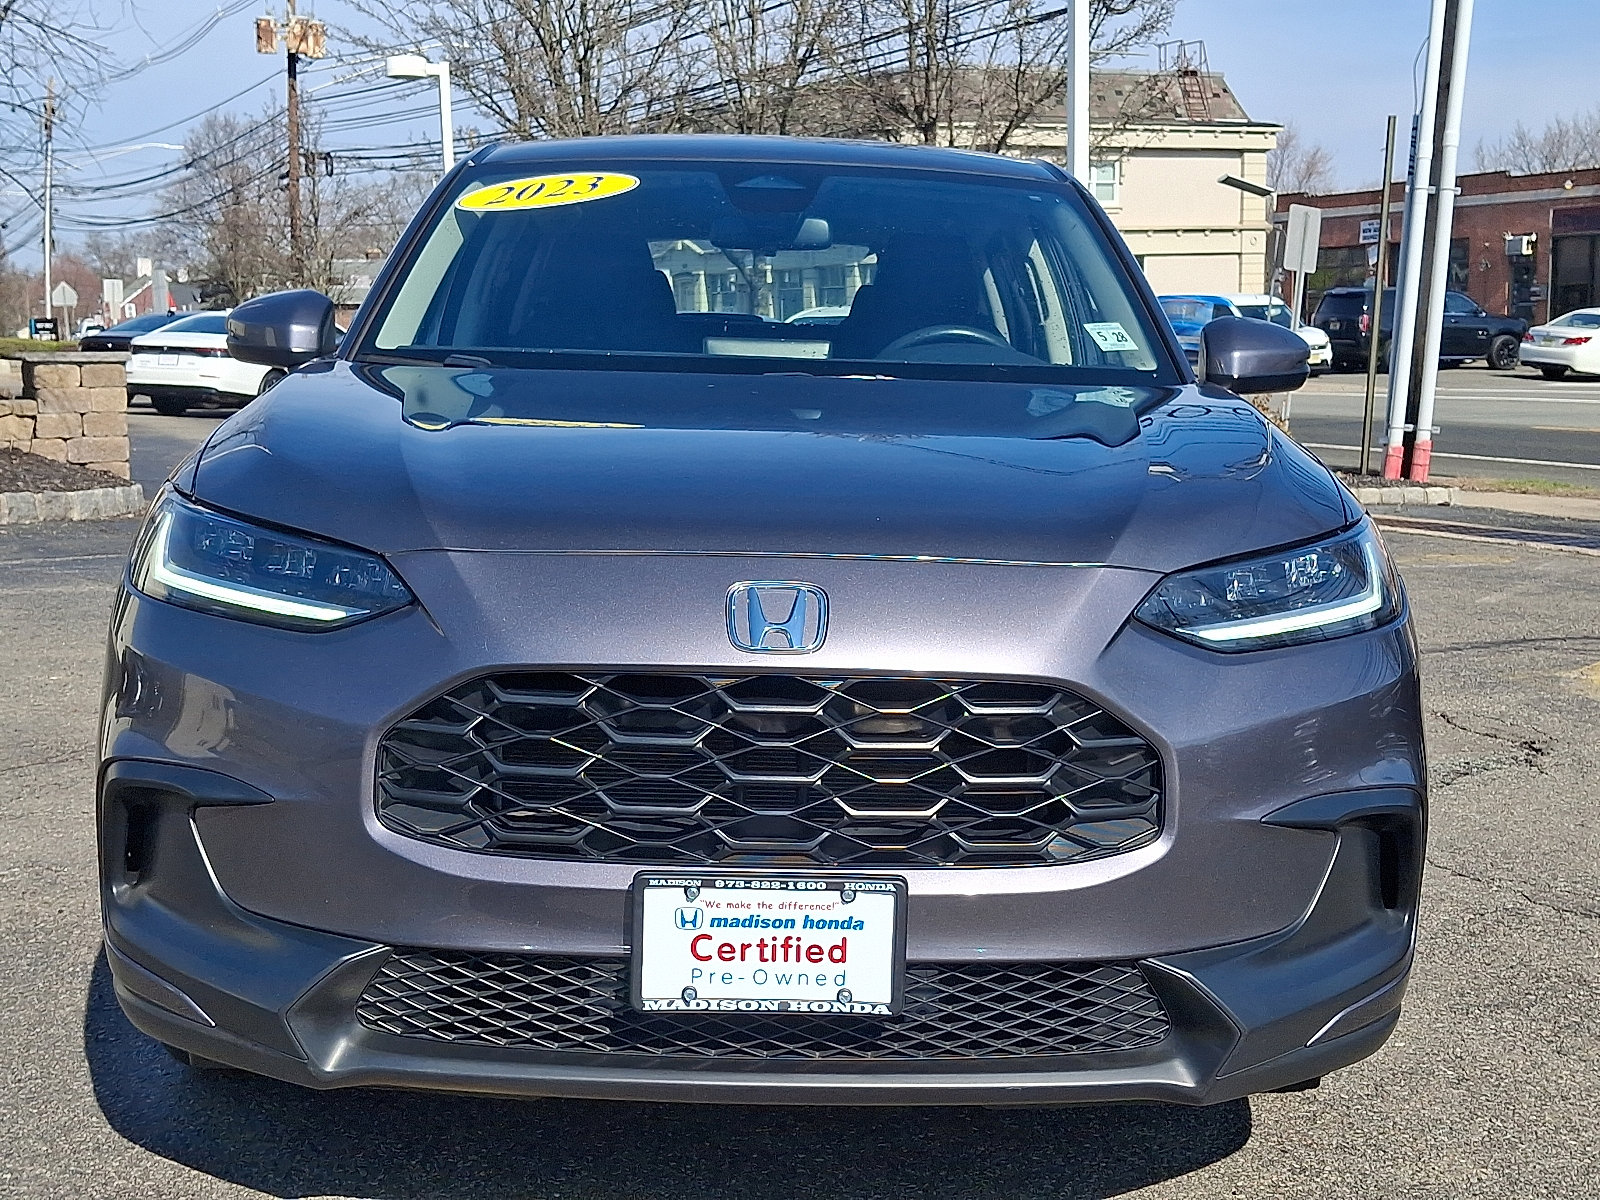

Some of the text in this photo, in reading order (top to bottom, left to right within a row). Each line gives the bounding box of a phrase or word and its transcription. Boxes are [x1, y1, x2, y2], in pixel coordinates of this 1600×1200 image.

[484, 176, 604, 206] 2023
[844, 882, 896, 892] HONDA
[726, 900, 752, 910] make
[757, 901, 773, 910] the
[710, 914, 864, 930] madison honda
[690, 934, 848, 964] Certified
[691, 968, 847, 986] Pre-Owned
[642, 1000, 892, 1015] MADISON HONDA
